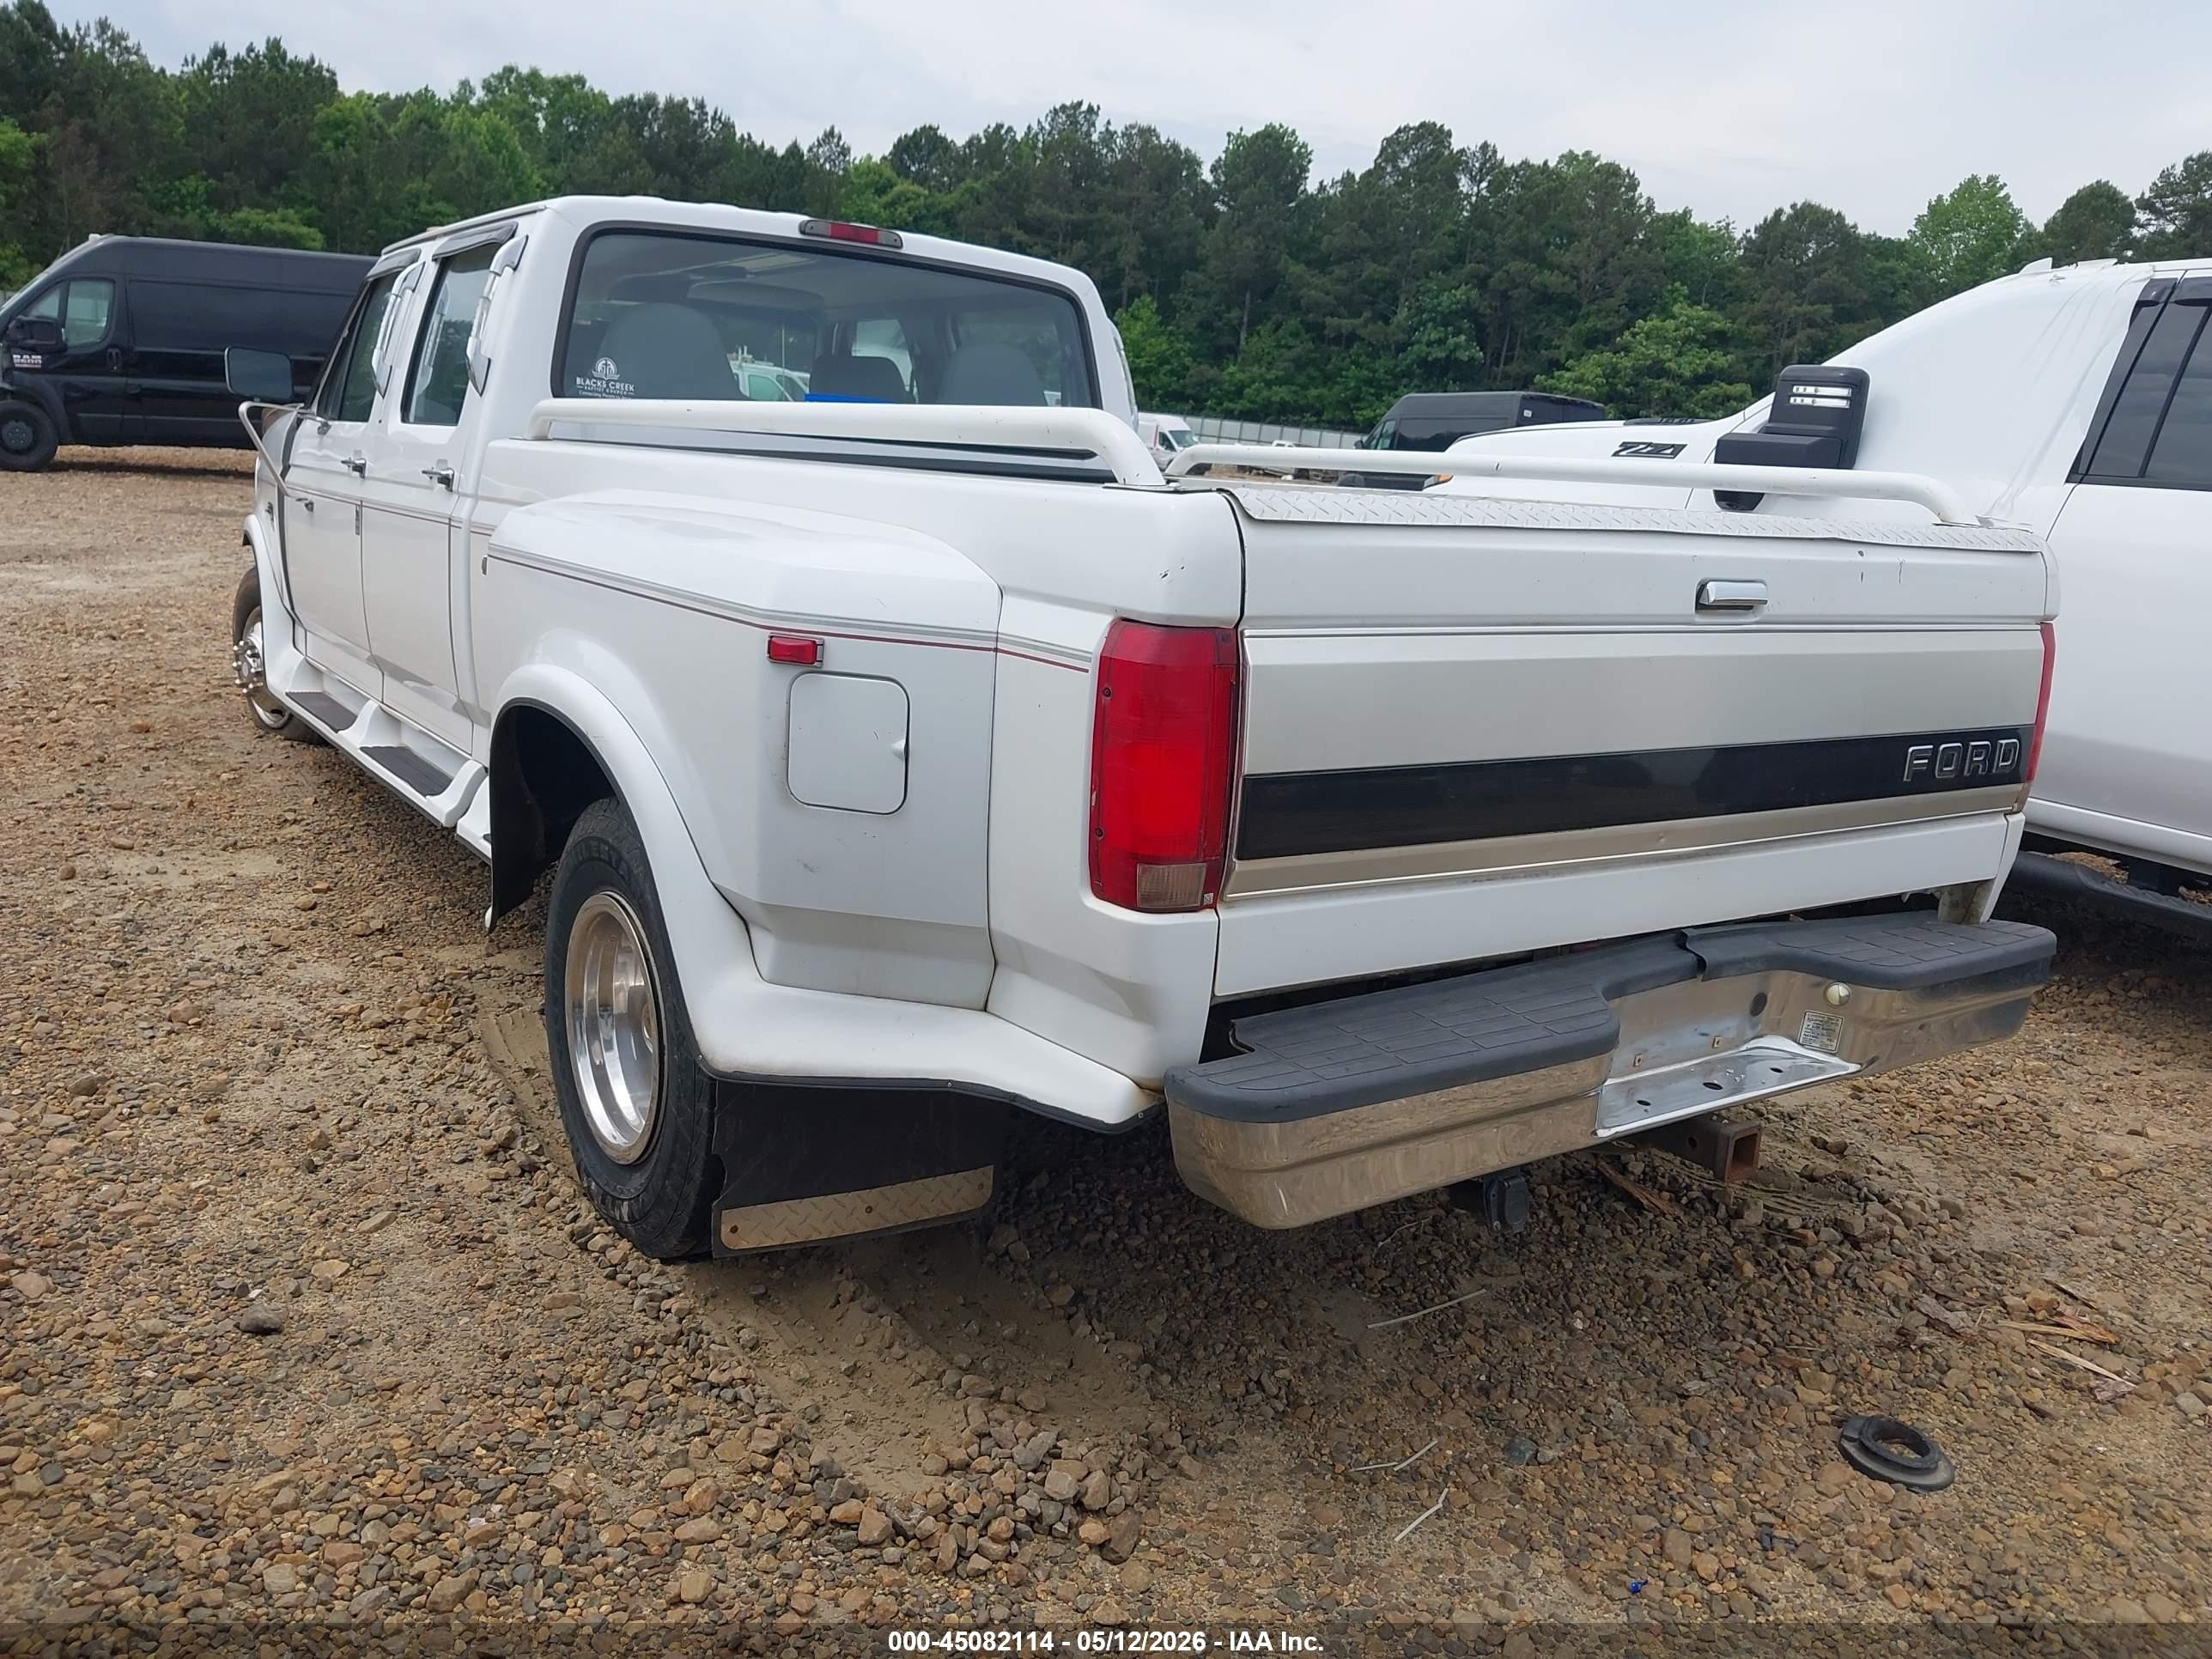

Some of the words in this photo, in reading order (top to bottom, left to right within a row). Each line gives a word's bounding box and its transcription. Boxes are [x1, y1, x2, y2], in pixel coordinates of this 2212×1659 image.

[576, 376, 606, 388] BLACKS
[608, 381, 635, 392] CREEK
[1902, 738, 2020, 782] FORD
